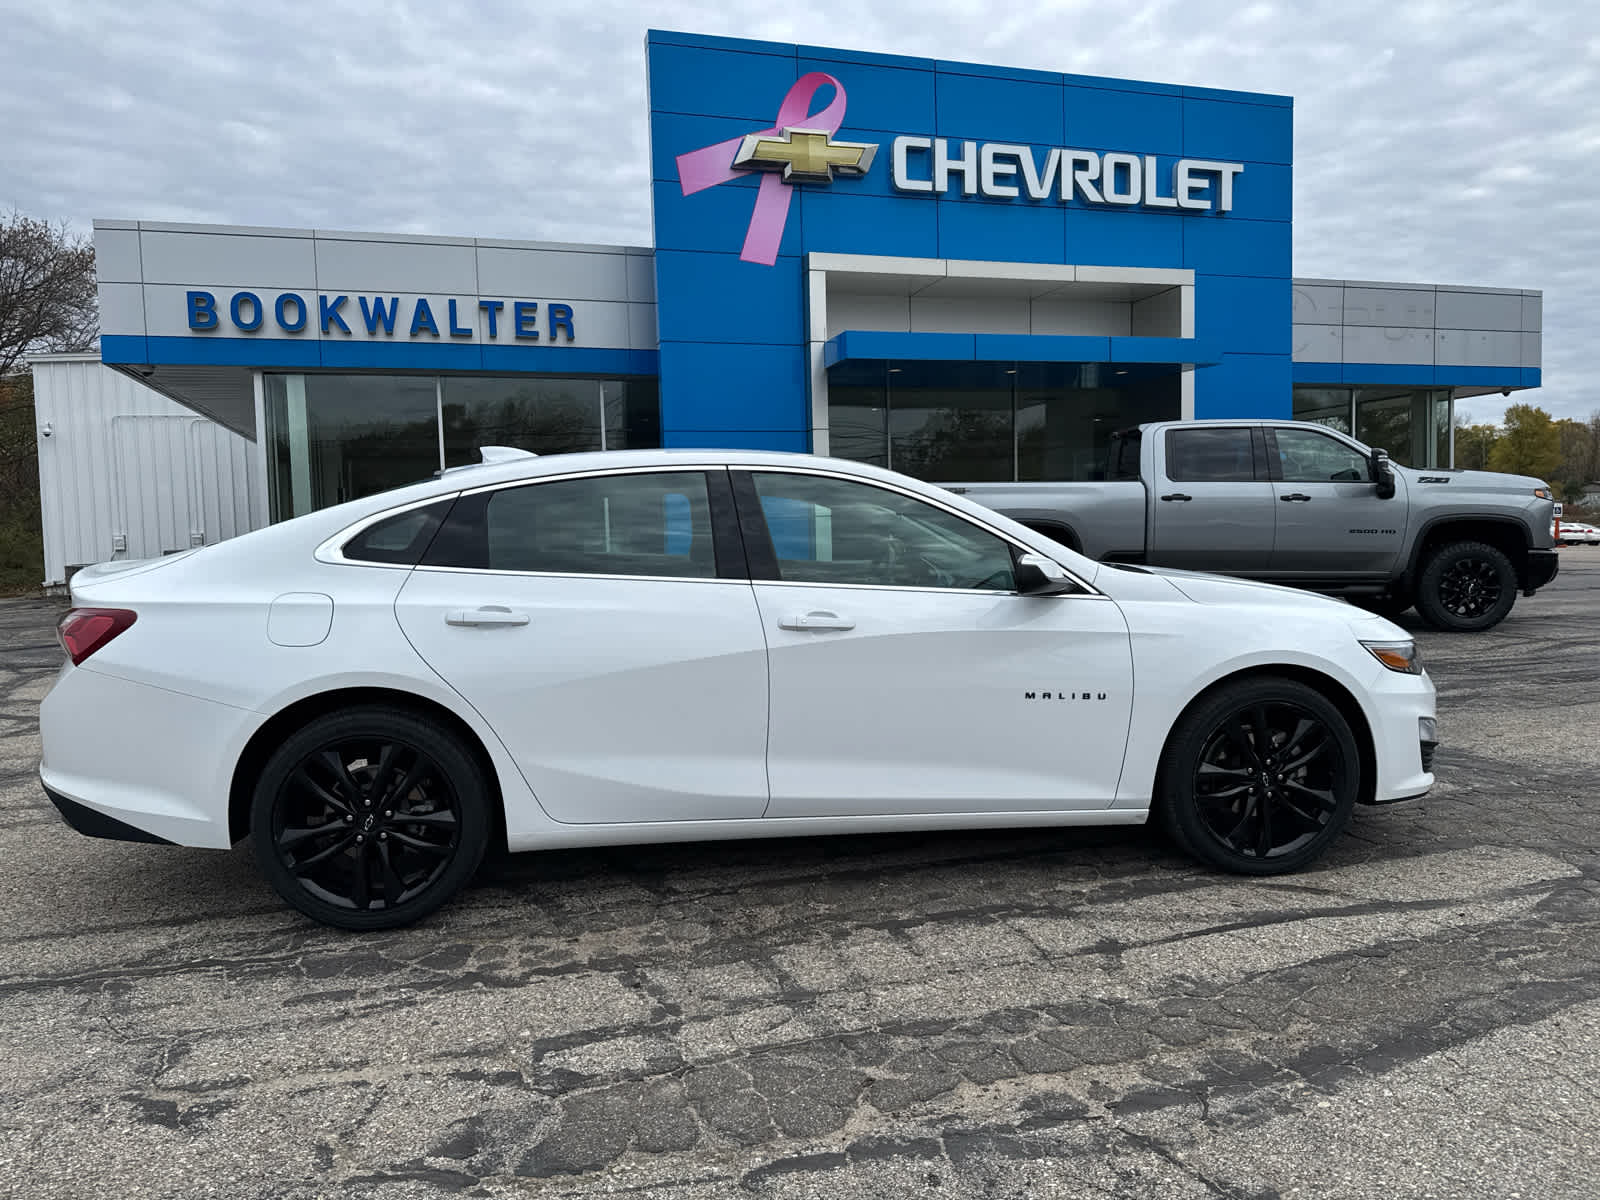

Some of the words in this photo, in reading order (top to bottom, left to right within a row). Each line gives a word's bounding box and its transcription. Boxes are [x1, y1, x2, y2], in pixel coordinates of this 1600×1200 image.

[892, 135, 1245, 214] CHEVROLET
[186, 290, 576, 341] BOOKWALTER
[1024, 692, 1107, 700] MALIBU
